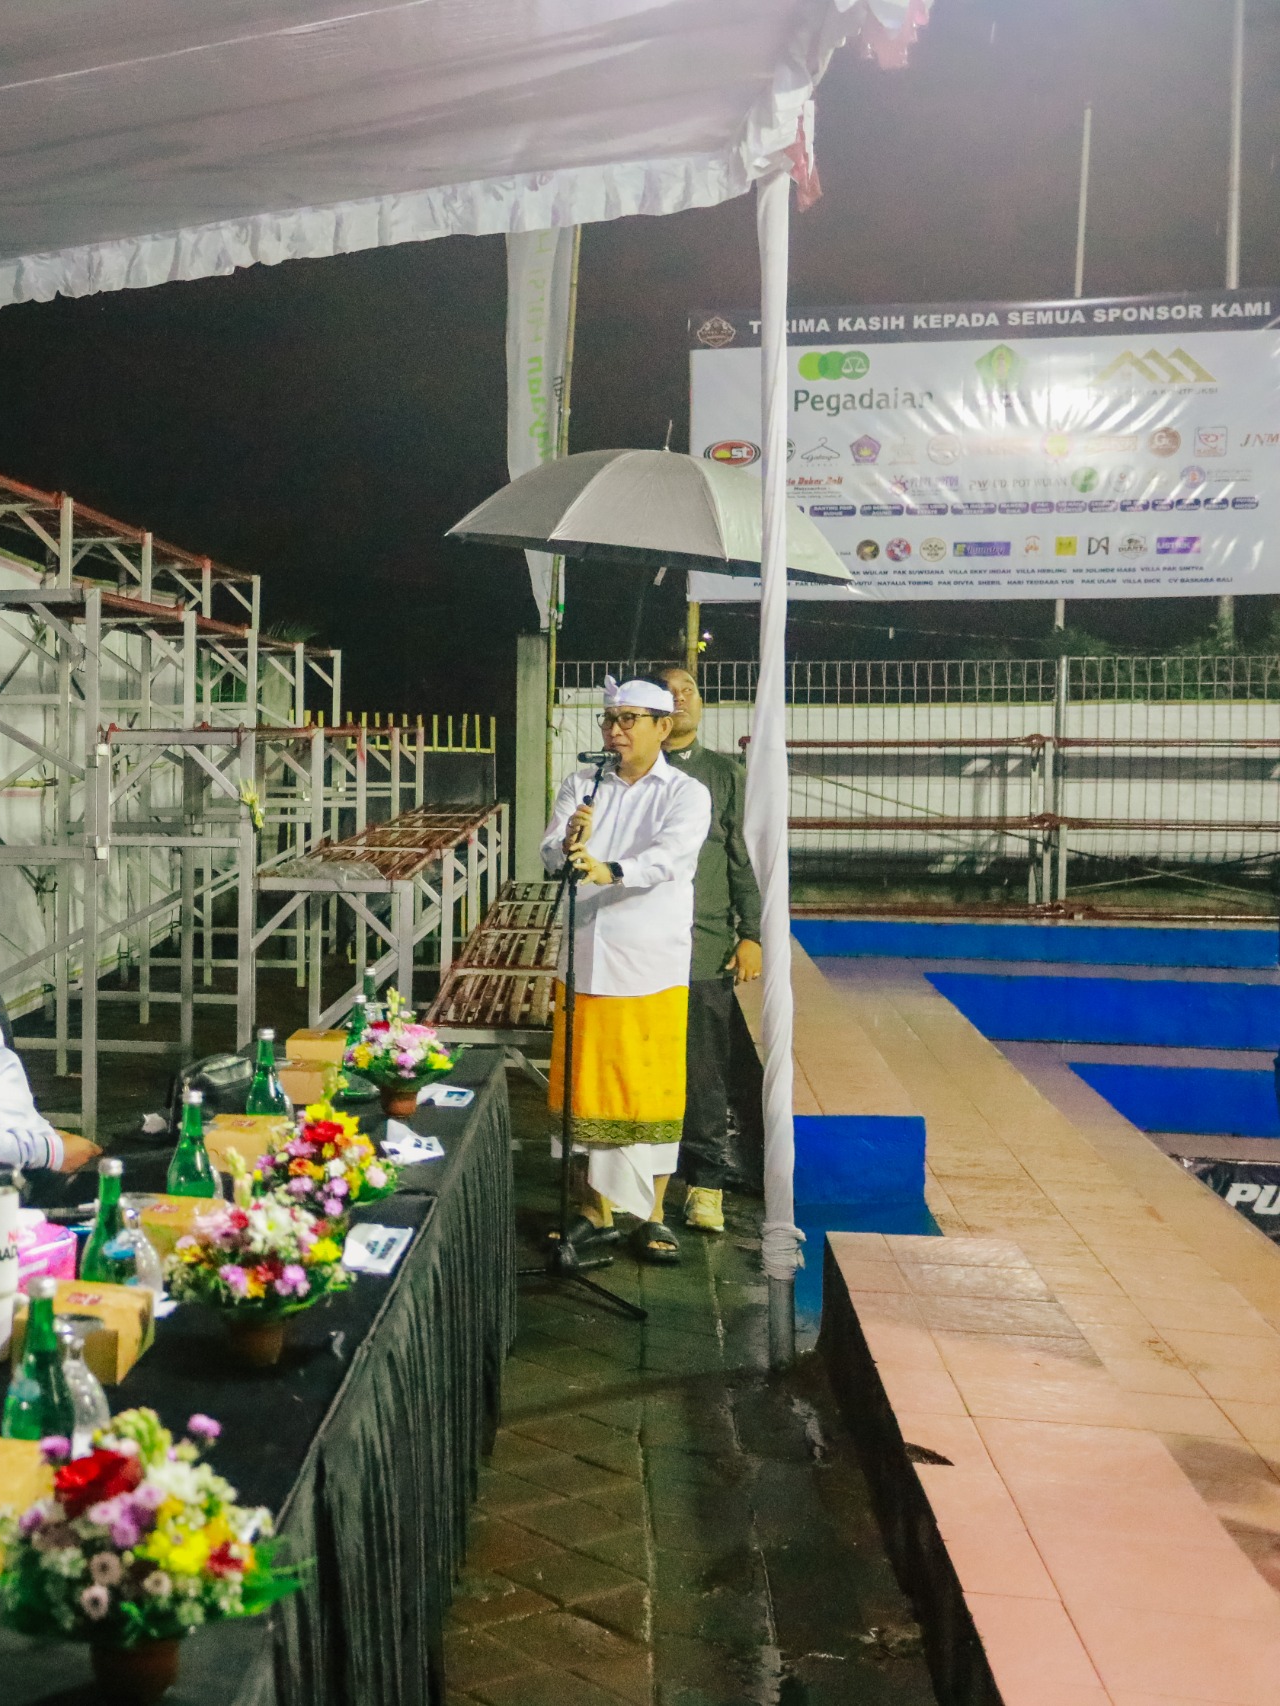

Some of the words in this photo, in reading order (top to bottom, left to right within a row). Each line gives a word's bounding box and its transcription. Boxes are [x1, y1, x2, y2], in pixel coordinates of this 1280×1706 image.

[749, 318, 830, 334] TRIMA
[838, 315, 905, 332] KASIH
[913, 312, 1000, 328] KEPADA
[1007, 309, 1086, 326] SEMUA
[1093, 304, 1203, 323] SPONSOR
[1211, 301, 1271, 318] KAMI
